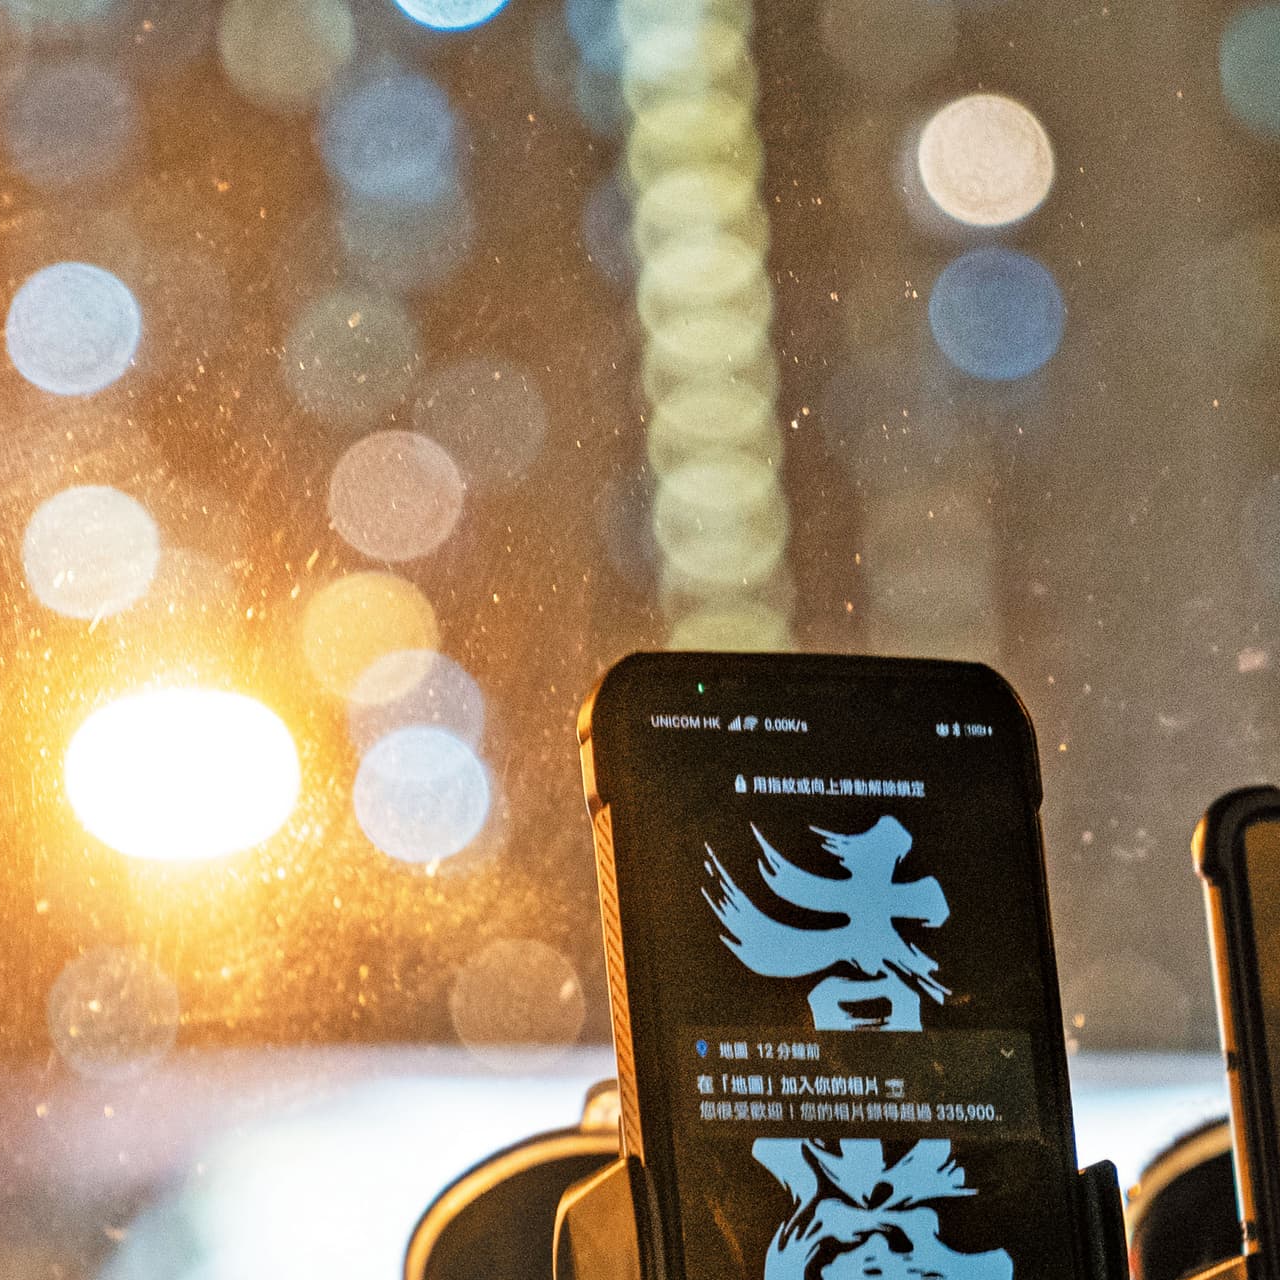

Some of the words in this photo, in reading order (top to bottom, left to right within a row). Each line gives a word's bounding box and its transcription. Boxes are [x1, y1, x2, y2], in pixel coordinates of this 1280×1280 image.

[650, 714, 701, 729] UNICOM
[703, 715, 721, 730] HK
[719, 1041, 749, 1060] 地圖
[756, 1042, 774, 1059] 12
